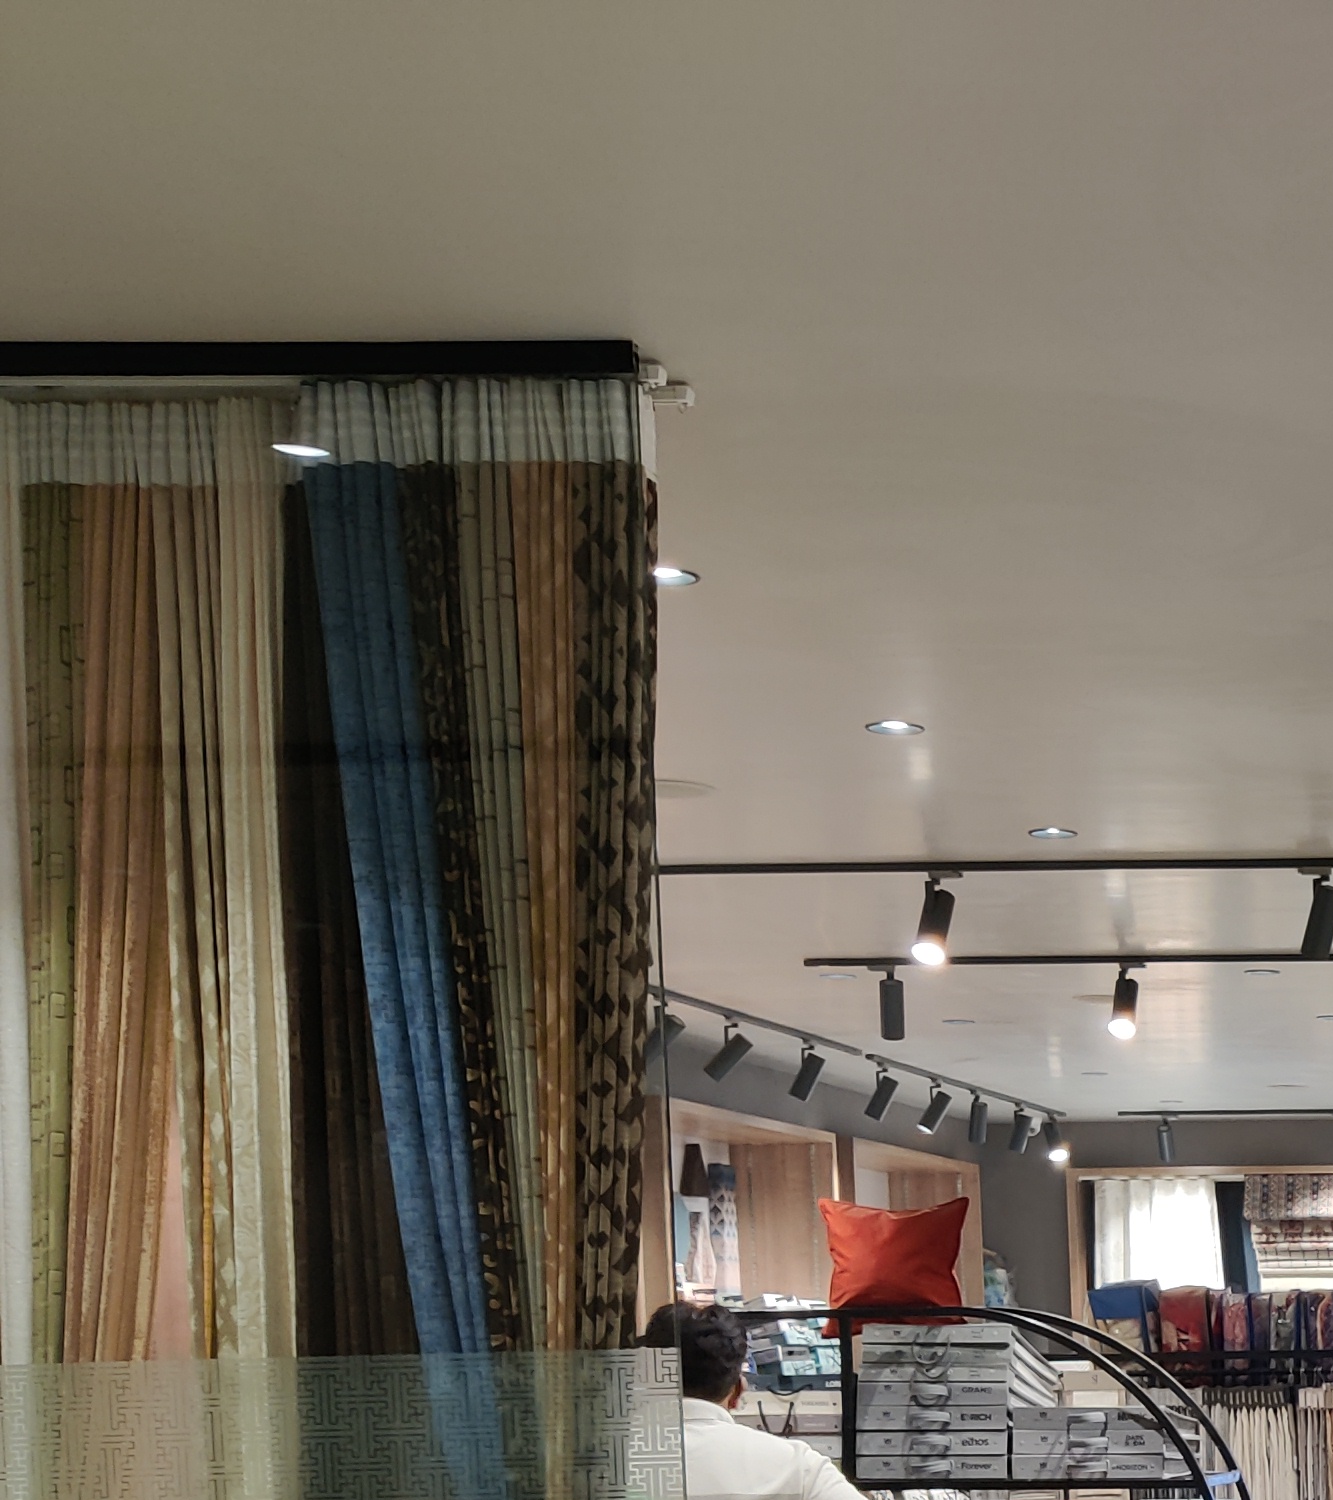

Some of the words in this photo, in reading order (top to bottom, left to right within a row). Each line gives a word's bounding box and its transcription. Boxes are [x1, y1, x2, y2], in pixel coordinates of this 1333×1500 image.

[960, 1413, 993, 1421] ENRICH
[961, 1437, 990, 1447] ethos
[960, 1462, 993, 1471] Forever
